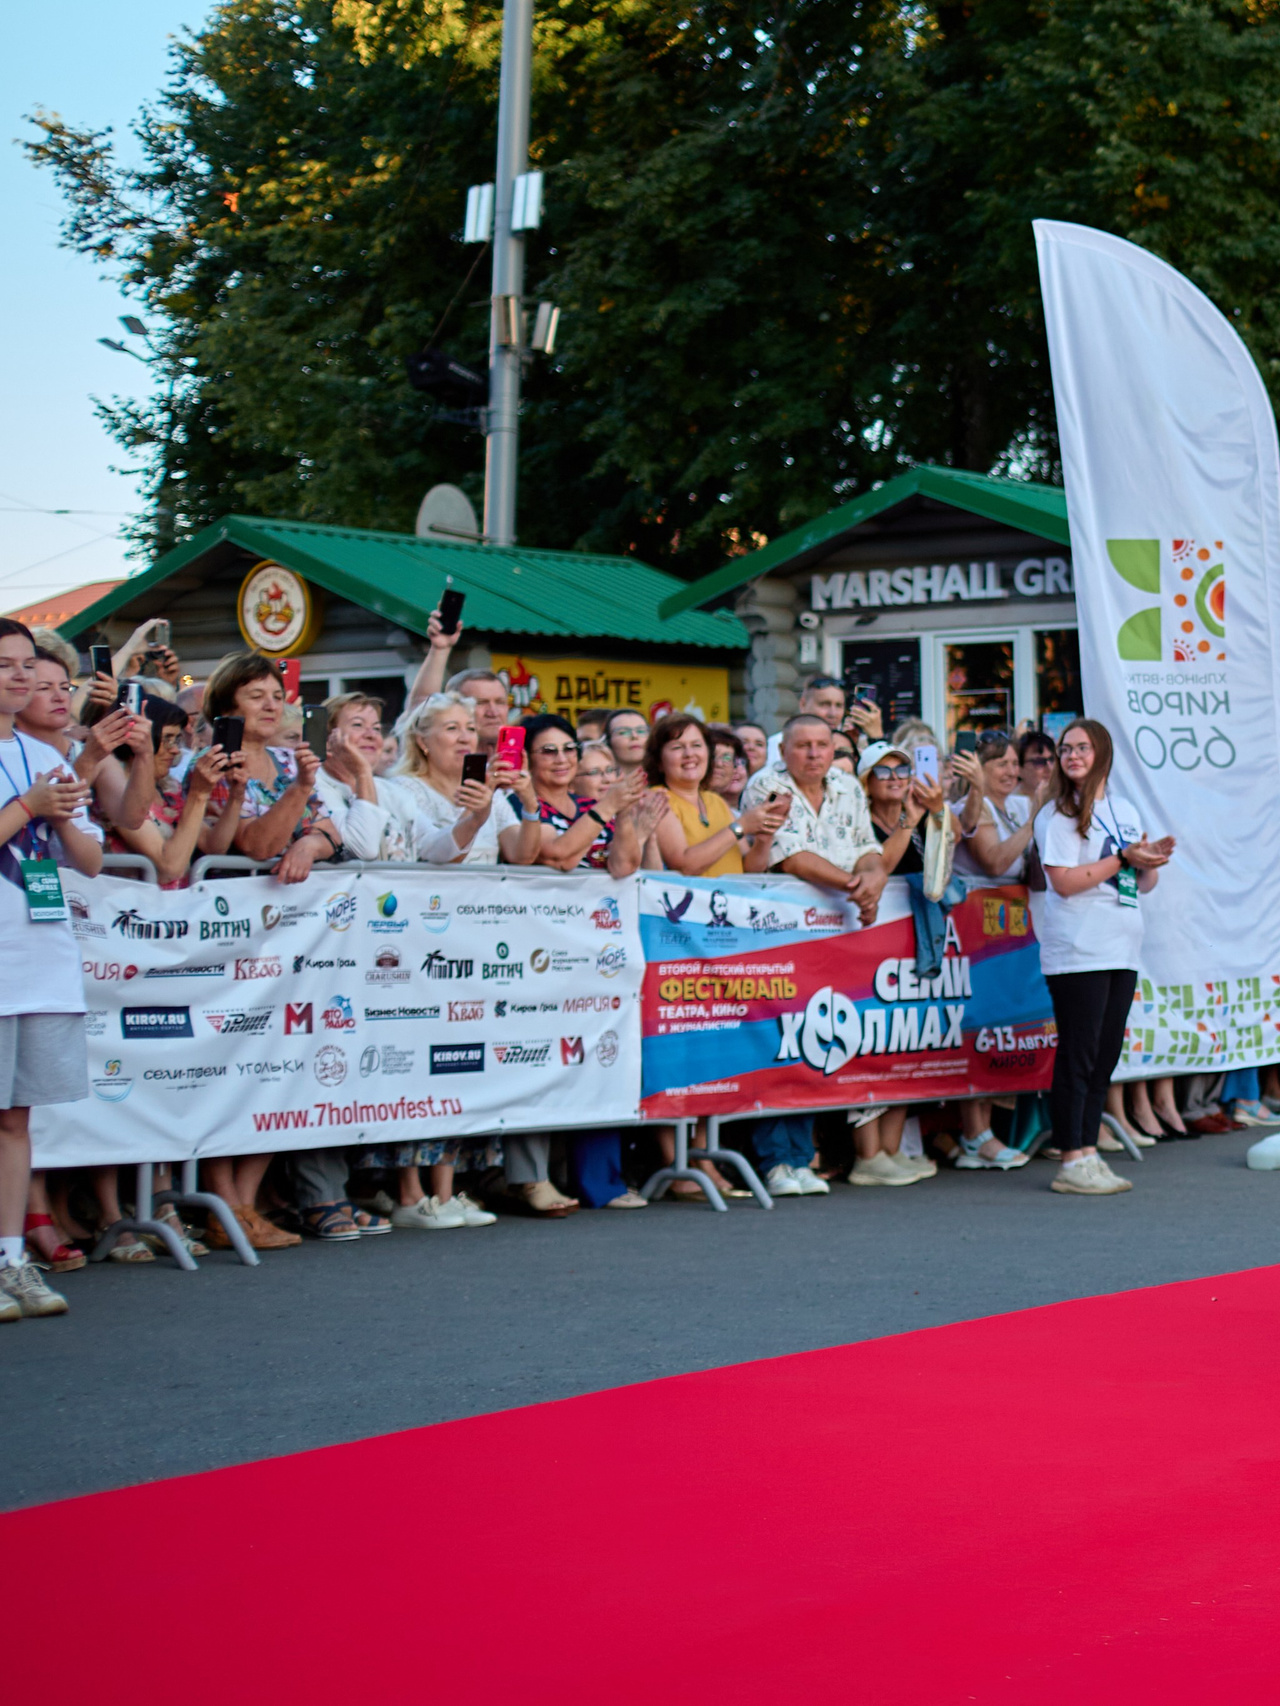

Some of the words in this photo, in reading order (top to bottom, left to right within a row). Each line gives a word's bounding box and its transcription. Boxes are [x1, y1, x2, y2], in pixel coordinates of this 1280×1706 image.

[811, 561, 1008, 611] MARSHALL
[1014, 557, 1076, 597] GR
[555, 671, 642, 704] ДАЙТЕ
[326, 896, 357, 924] МОРЕ
[199, 918, 251, 941] ВЯТИЧ
[367, 918, 410, 929] ПЕРВЫЙ
[595, 919, 622, 931] РАДИО
[943, 915, 962, 954] А
[305, 958, 334, 970] Киров
[336, 957, 357, 969] Град
[596, 947, 627, 970] МОРЕ
[481, 962, 524, 980] ВЯТИЧ
[658, 962, 701, 976] ВТОРОЙ
[702, 962, 745, 976] ВЯТСКИЙ
[746, 960, 795, 976] ОТКРЫТЫЙ
[873, 955, 973, 1002] СЕМИ
[659, 977, 798, 1002] ФЕСТИВАЛЬ
[364, 1006, 397, 1017] Бизнес
[398, 1004, 440, 1016] Новости
[510, 1004, 537, 1014] Киров
[658, 1004, 710, 1020] ТЕАТРА,
[711, 1003, 748, 1018] КИНО
[125, 1014, 187, 1026] KIROV.RU
[324, 1018, 356, 1030] РАДИО
[658, 1023, 666, 1034] И
[669, 1019, 742, 1034] ЖУРНАЛИСТИКИ
[975, 1025, 1017, 1053] 6-13
[1017, 1033, 1059, 1052] АВГУС
[433, 1048, 482, 1063] KIROV.RU
[989, 1053, 1036, 1069] КИРОВ
[252, 1095, 463, 1132] www.7holmovfest.ru
